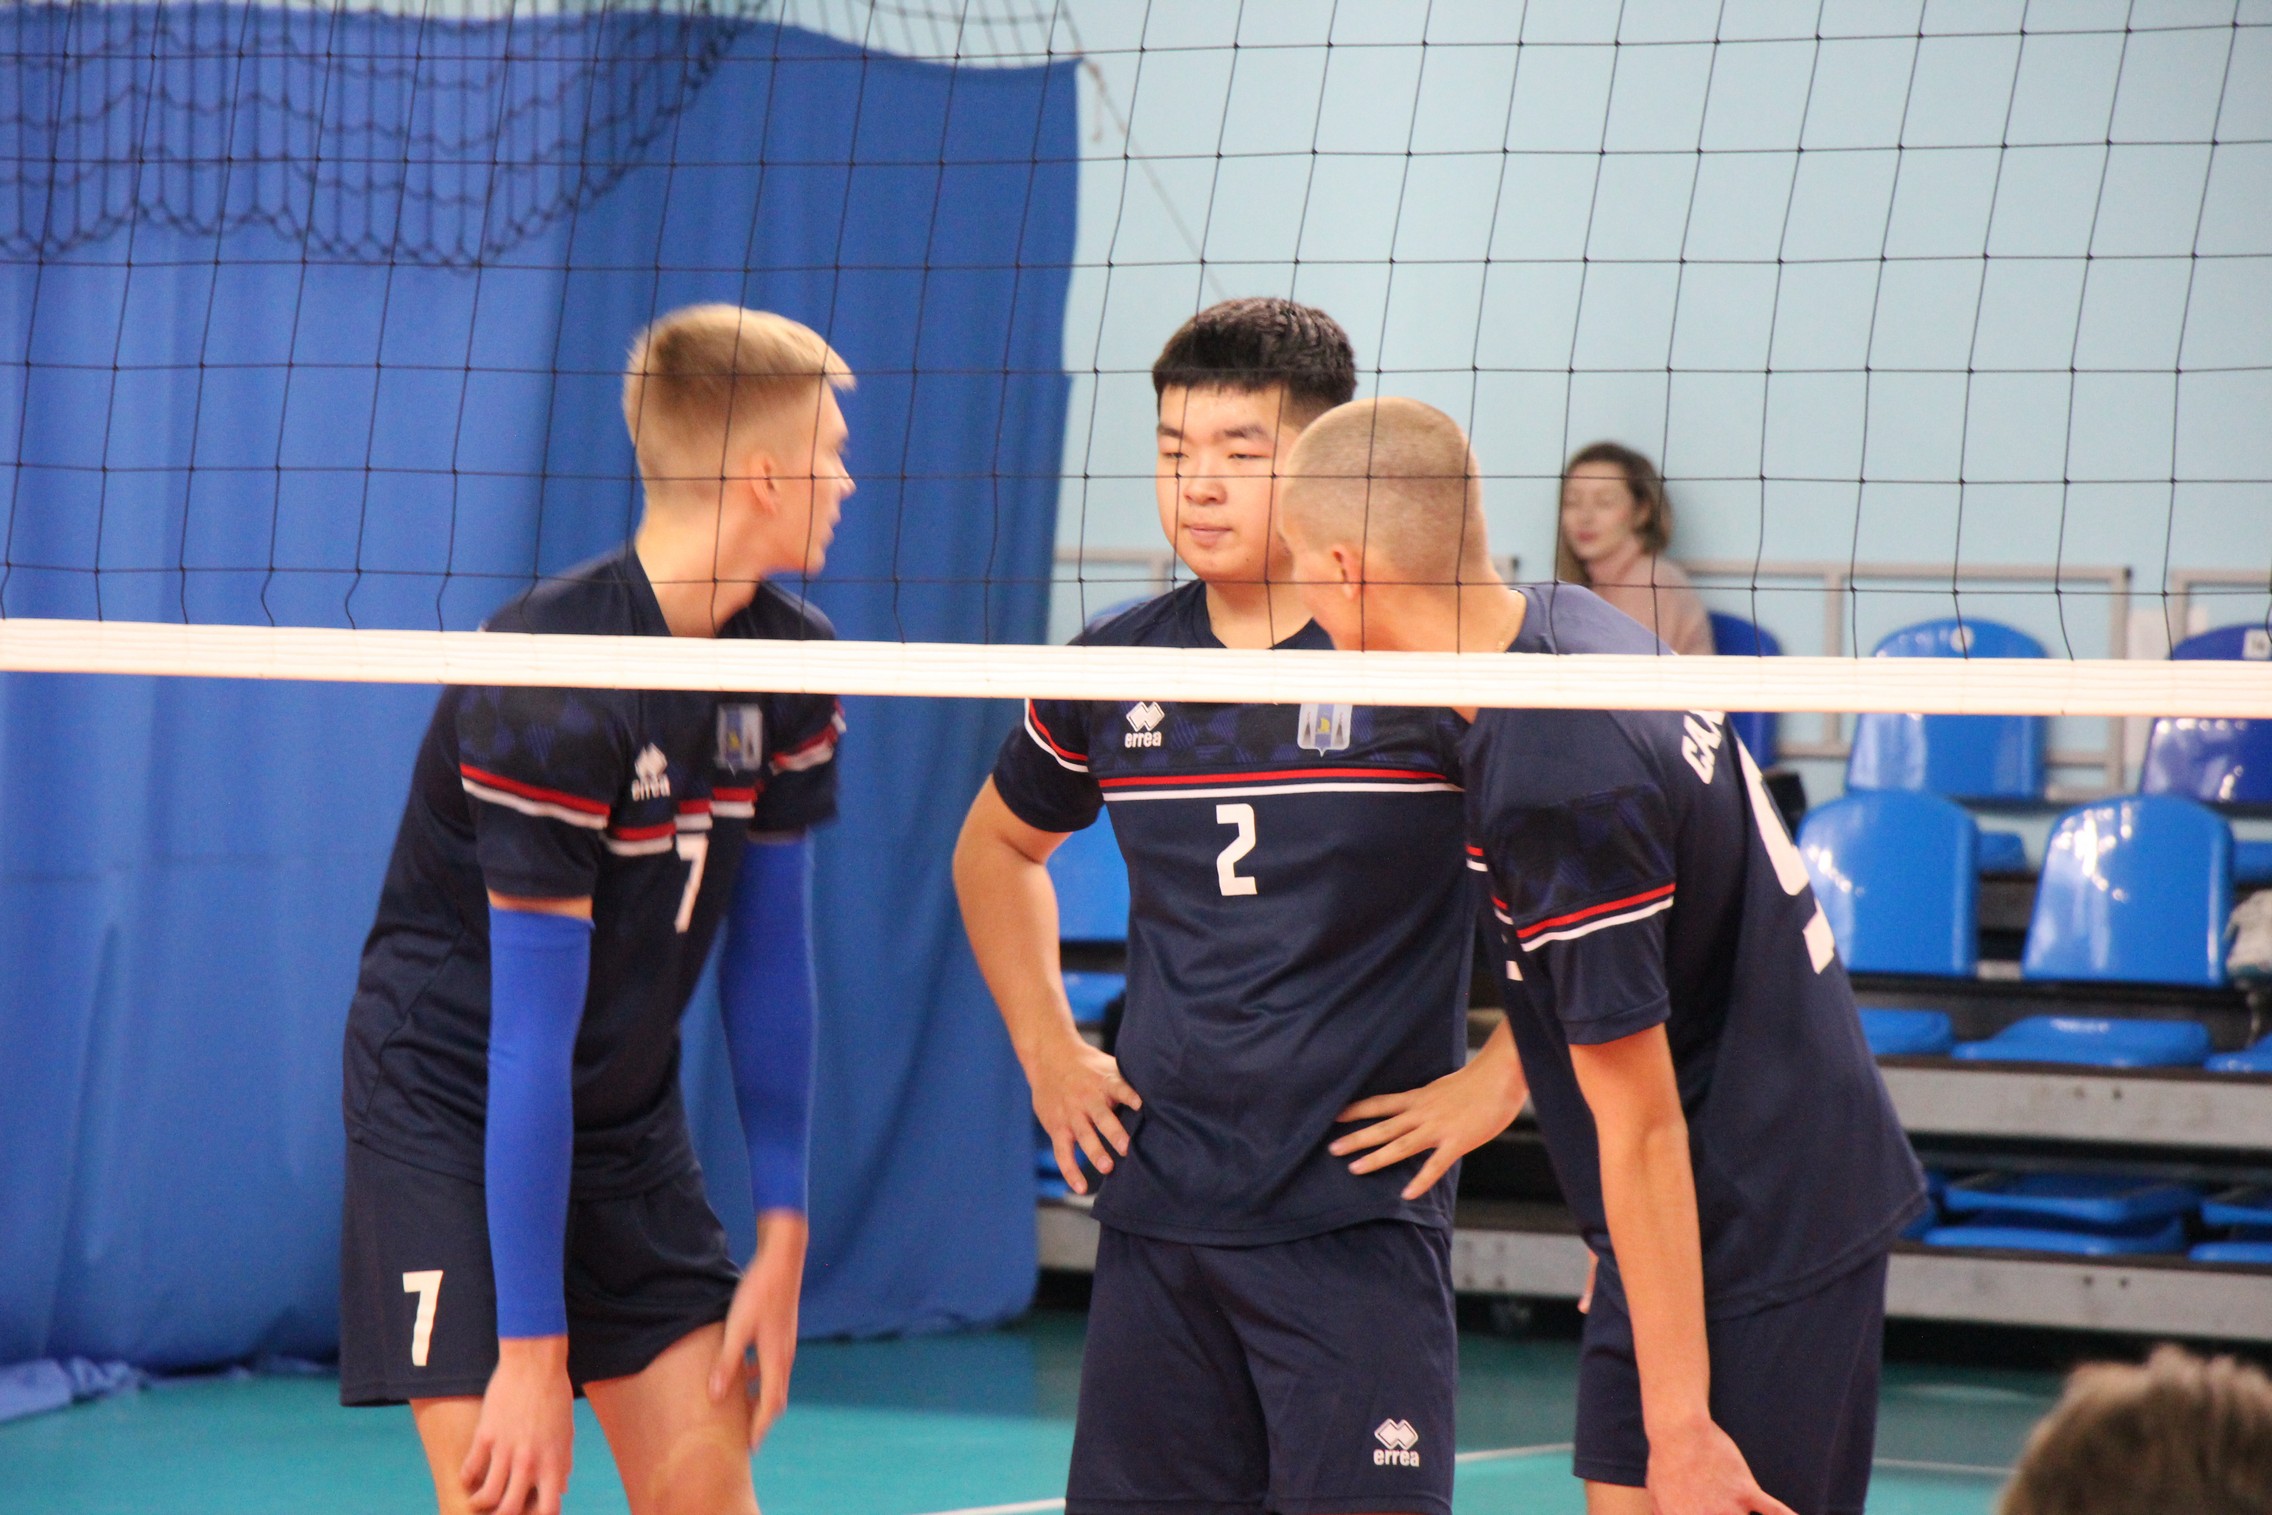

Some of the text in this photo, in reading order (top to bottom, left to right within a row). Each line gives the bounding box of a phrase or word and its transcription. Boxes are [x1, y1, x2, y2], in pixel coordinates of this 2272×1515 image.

[674, 833, 709, 933] 7
[1216, 803, 1257, 896] 2
[402, 1269, 444, 1367] 7
